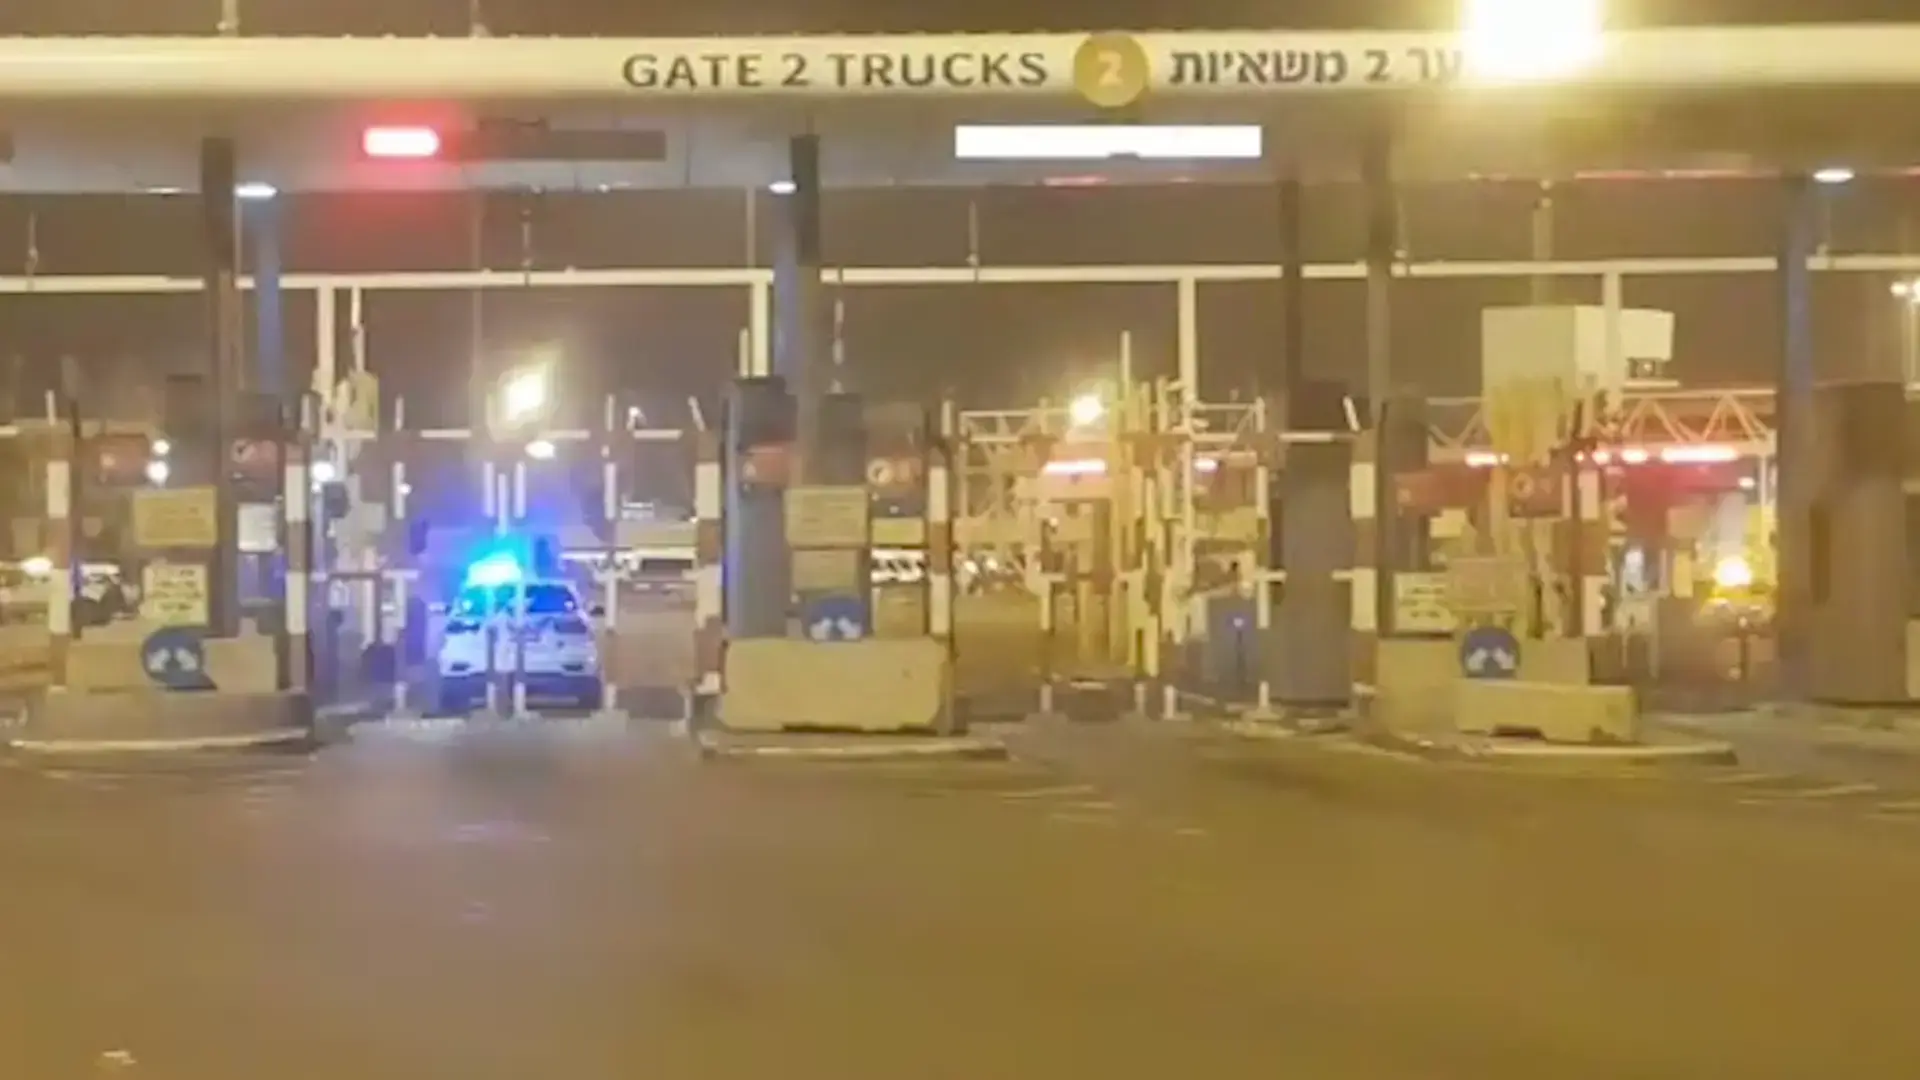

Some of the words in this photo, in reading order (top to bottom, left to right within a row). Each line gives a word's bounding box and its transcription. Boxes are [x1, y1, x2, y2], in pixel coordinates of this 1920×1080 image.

[622, 53, 763, 89] GATE
[780, 54, 813, 87] 2
[827, 52, 1049, 88] TRUCKS
[1097, 50, 1124, 87] 2
[1168, 49, 1348, 85] משאיות
[1363, 48, 1391, 82] 2
